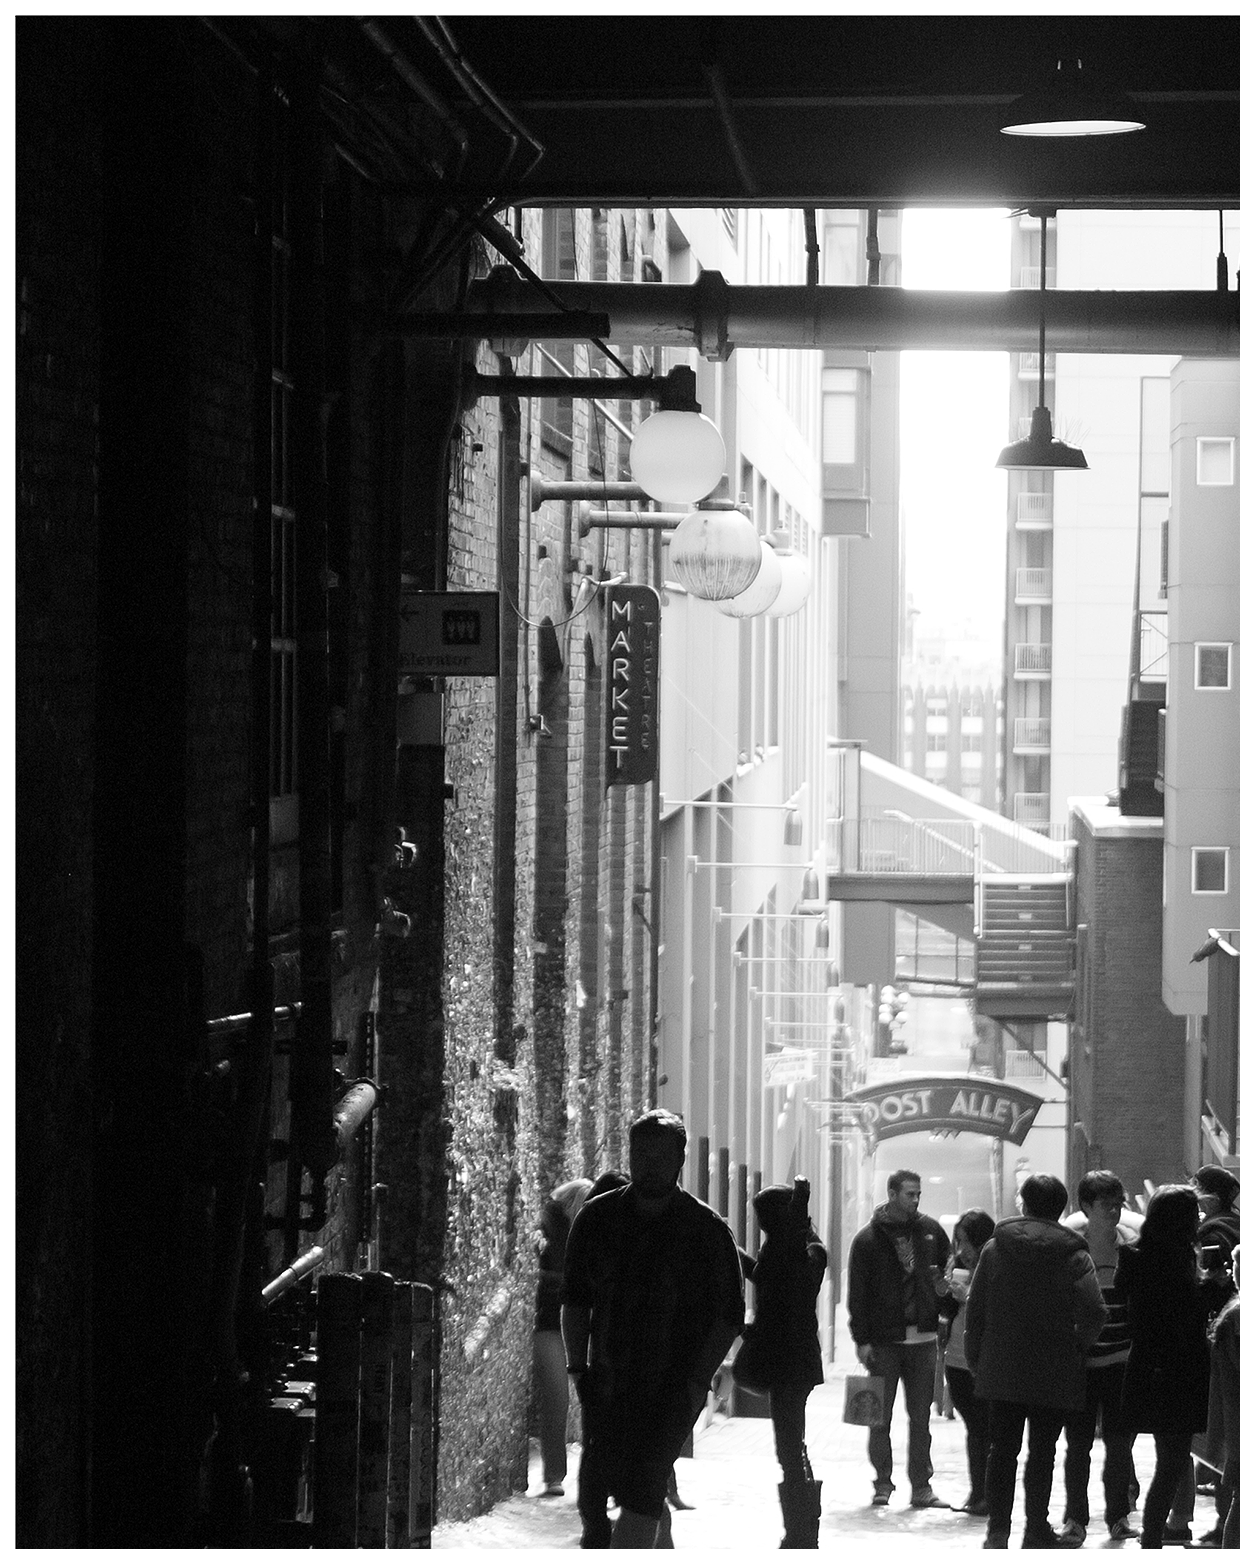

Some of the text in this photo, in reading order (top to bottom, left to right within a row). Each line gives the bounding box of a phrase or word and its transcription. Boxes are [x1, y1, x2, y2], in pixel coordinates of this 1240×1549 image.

[609, 601, 631, 769] MARKET
[641, 621, 653, 749] THEATRE
[862, 1089, 1036, 1136] POST ALLEY
